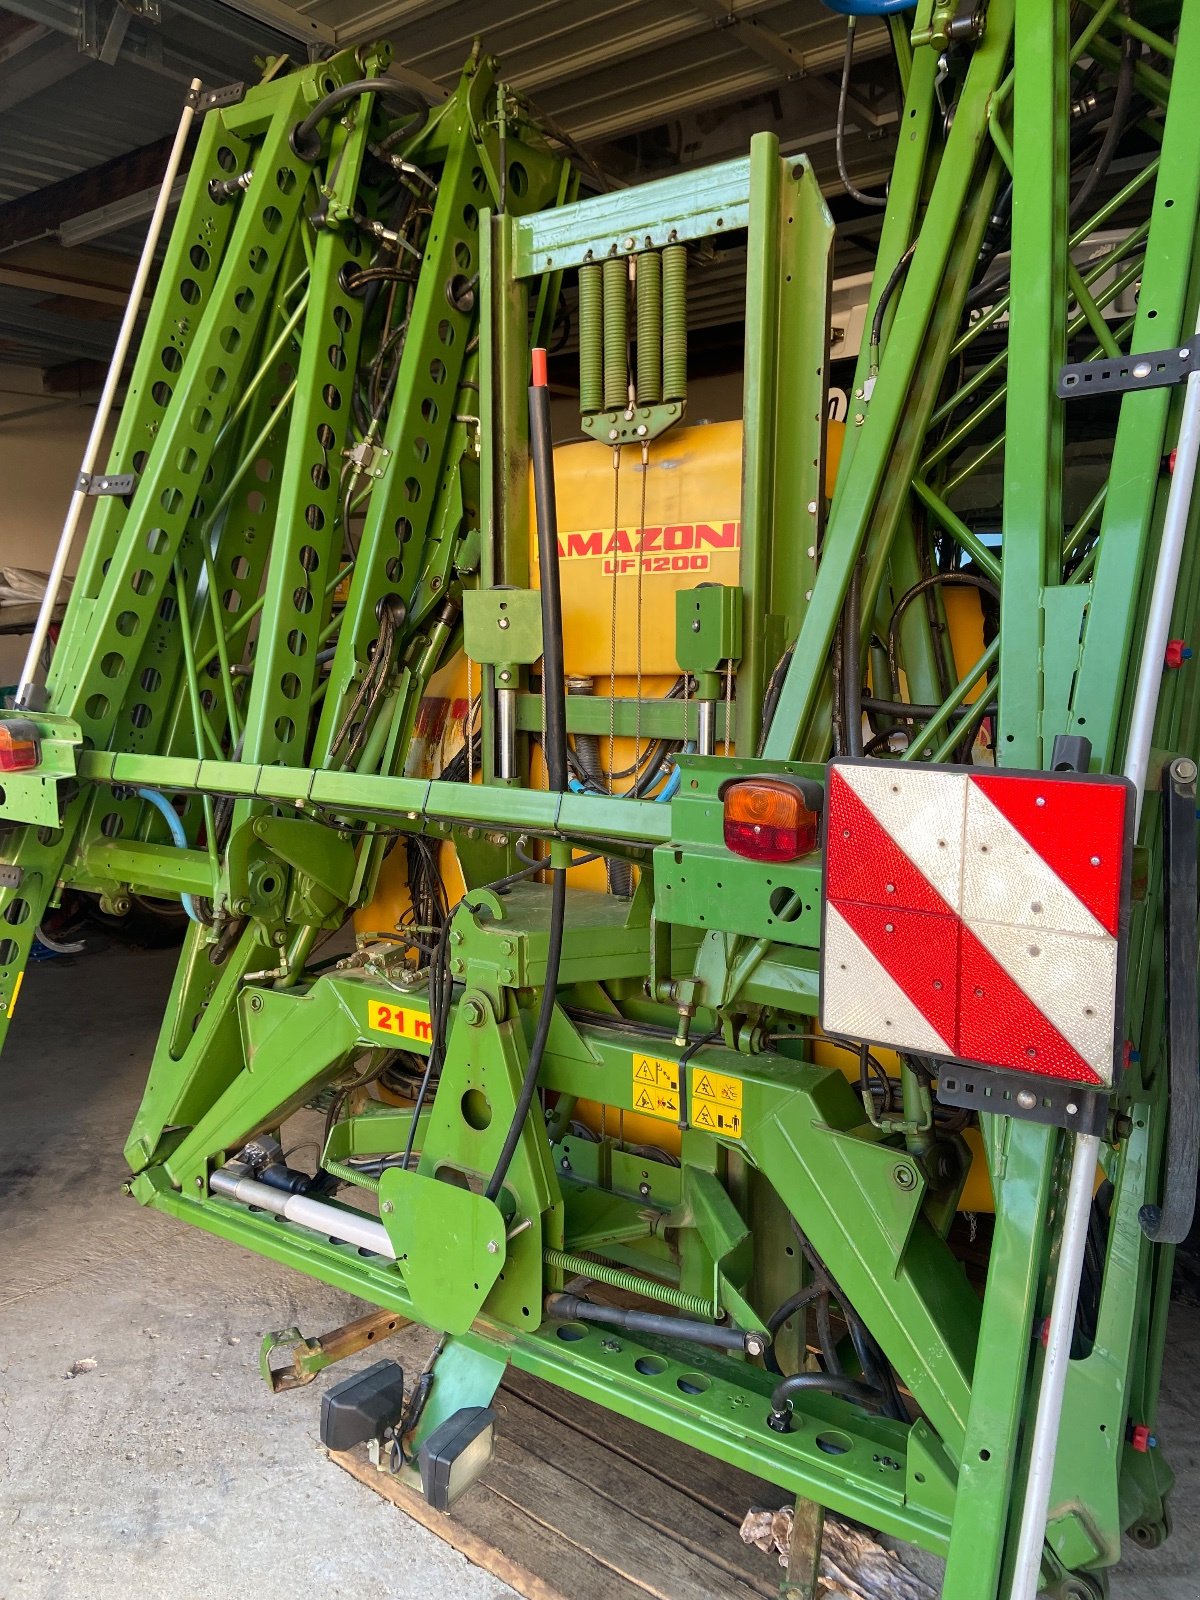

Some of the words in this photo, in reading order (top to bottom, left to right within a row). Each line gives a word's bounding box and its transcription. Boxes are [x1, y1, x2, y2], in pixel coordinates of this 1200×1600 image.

[555, 523, 740, 558] MAZON
[604, 559, 635, 574] UF
[641, 555, 708, 572] 1200
[377, 1006, 405, 1033] 21
